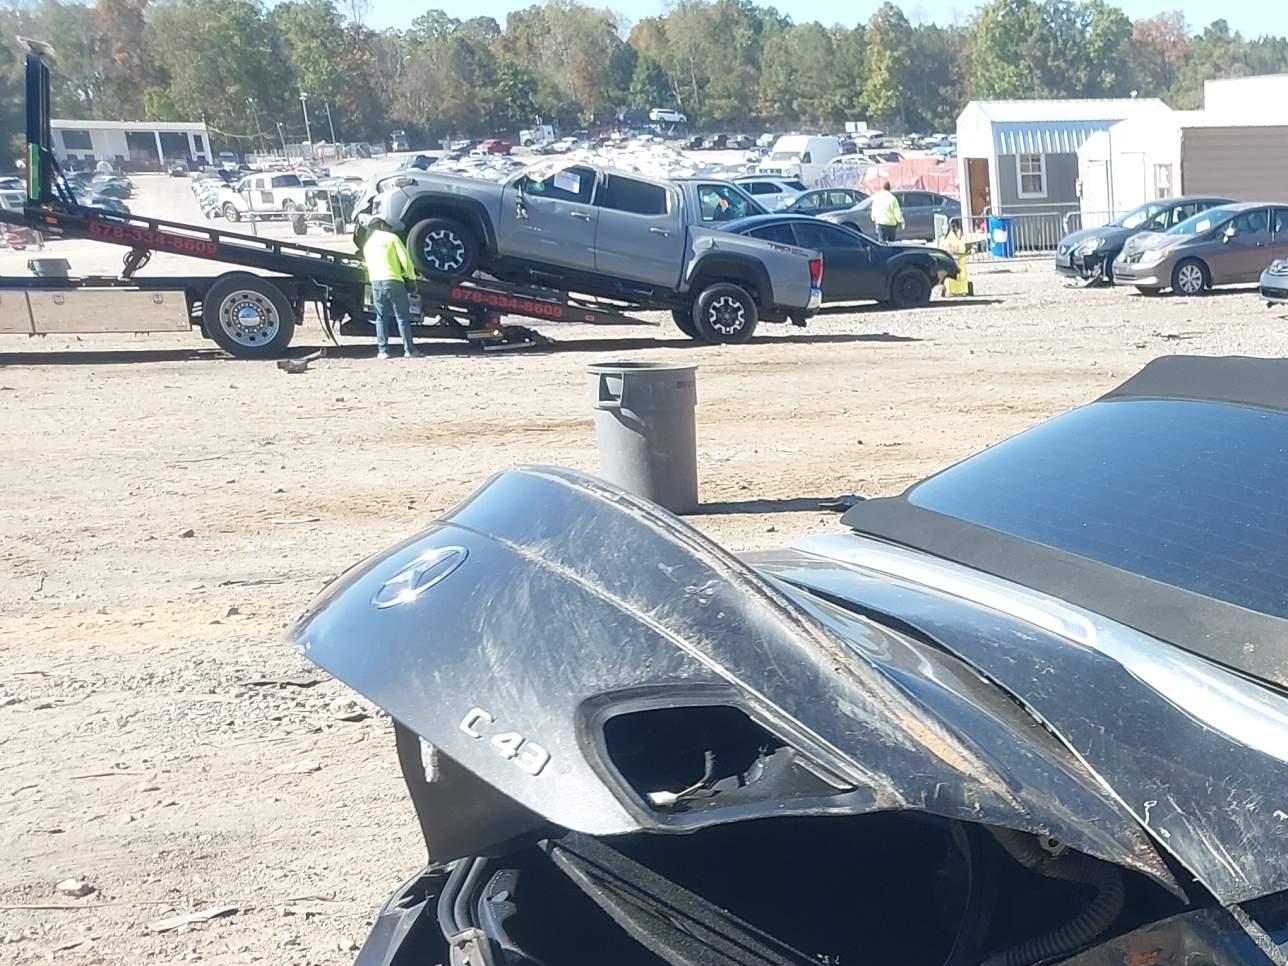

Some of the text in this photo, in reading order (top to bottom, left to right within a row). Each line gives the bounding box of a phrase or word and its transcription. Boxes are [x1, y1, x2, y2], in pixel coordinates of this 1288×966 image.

[452, 287, 563, 317] 678-334-8609
[459, 707, 551, 776] C 43
